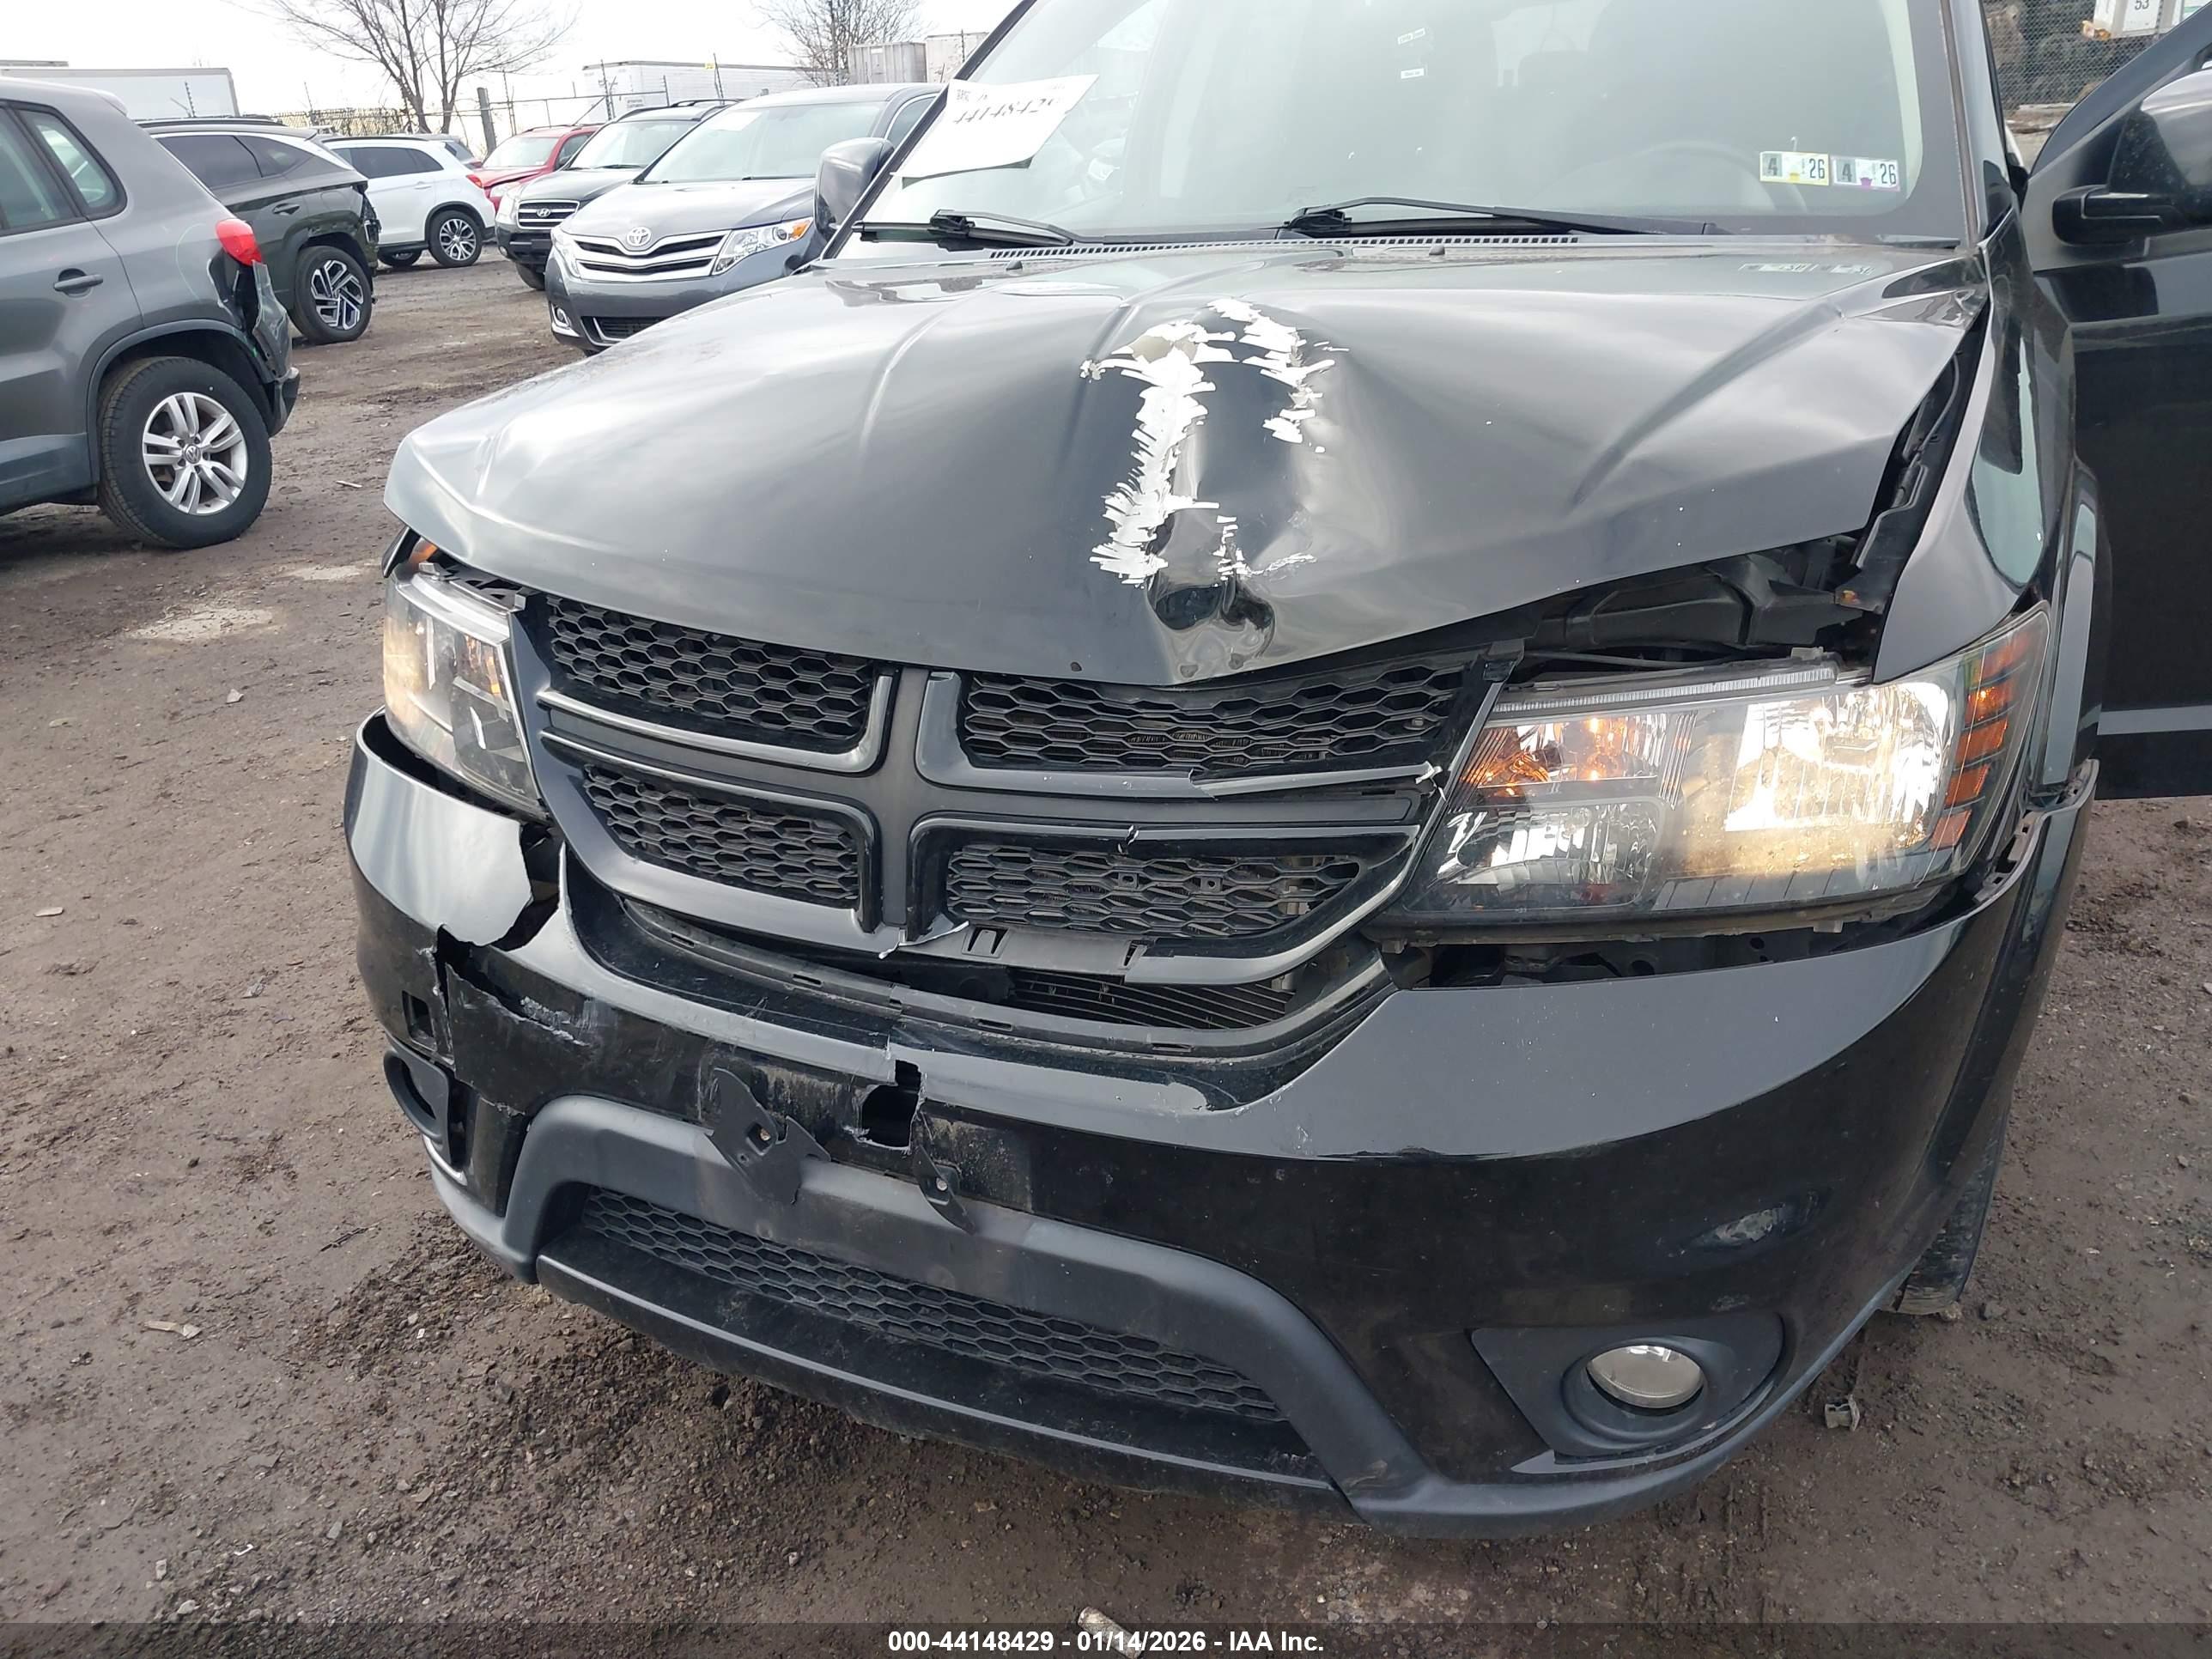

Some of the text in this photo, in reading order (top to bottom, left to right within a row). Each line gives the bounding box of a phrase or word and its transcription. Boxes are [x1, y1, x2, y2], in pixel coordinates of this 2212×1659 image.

[1767, 158, 1826, 179] 4 26
[1842, 163, 1897, 185] 4 26
